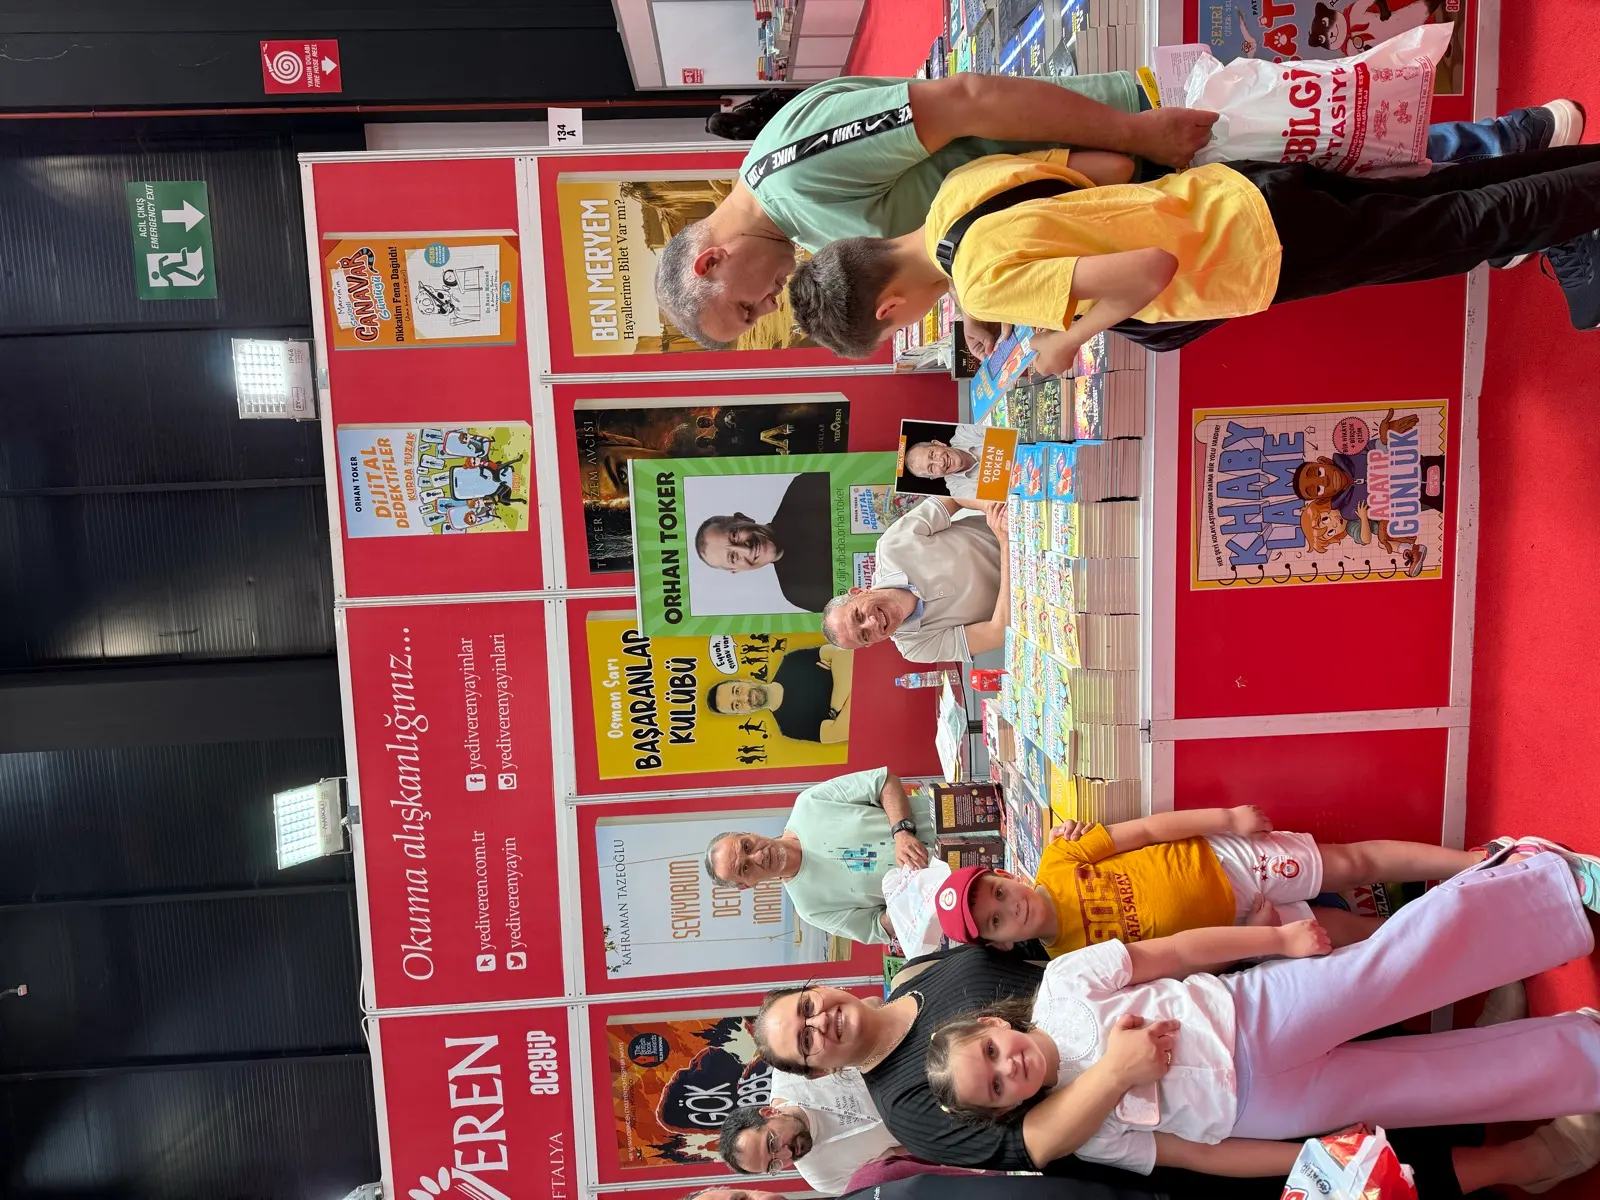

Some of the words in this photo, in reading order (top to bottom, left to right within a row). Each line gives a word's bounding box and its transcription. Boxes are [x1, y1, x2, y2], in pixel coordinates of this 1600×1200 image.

[1209, 5, 1224, 46] ŞEHRİ
[557, 124, 566, 142] 134
[832, 121, 862, 144] NIKE
[771, 144, 797, 169] NIKE
[136, 198, 147, 218] ÇIKIŞ
[145, 184, 154, 200] EXIT
[614, 199, 626, 213] mı?
[148, 202, 159, 249] EMERGENCY
[580, 199, 615, 293] MERYEM
[616, 223, 628, 244] Var
[388, 246, 401, 280] Dağıldı!
[618, 247, 630, 272] Bilet
[339, 247, 380, 342] CANAVAR
[392, 282, 401, 303] Fena
[620, 275, 635, 340] Hayallerime
[394, 306, 404, 342] Dikkatim
[588, 300, 619, 341] BEN
[350, 456, 359, 482] TOKER
[404, 432, 416, 465] TUZAK
[982, 445, 995, 484] ORHAN
[992, 449, 1004, 481] TOKER
[353, 486, 362, 512] ORHAN
[404, 469, 417, 501] KURDA
[1216, 421, 1268, 566] KHABY
[1262, 431, 1305, 550] LAME
[1390, 429, 1420, 535] GÜNLÜK
[656, 471, 678, 543] TOKER
[660, 550, 683, 624] ORHAN
[602, 658, 622, 688] Sarı
[458, 638, 486, 770] yediverenyayinlar
[490, 633, 517, 769] yediverenyayinlari
[607, 692, 624, 738] Osman
[665, 657, 697, 744] KULÜBÜ
[383, 627, 431, 859] alışkanlığınız...
[472, 830, 496, 951] yediveren.com.tr
[613, 839, 627, 899] TAZEOĞLU
[503, 837, 527, 949] yediverenyayin
[1115, 873, 1141, 941] ATASARAY
[400, 868, 434, 981] Okuma
[618, 903, 632, 965] KAHRAMAN
[526, 1031, 560, 1095] acayip
[678, 1082, 734, 1126] GÖK
